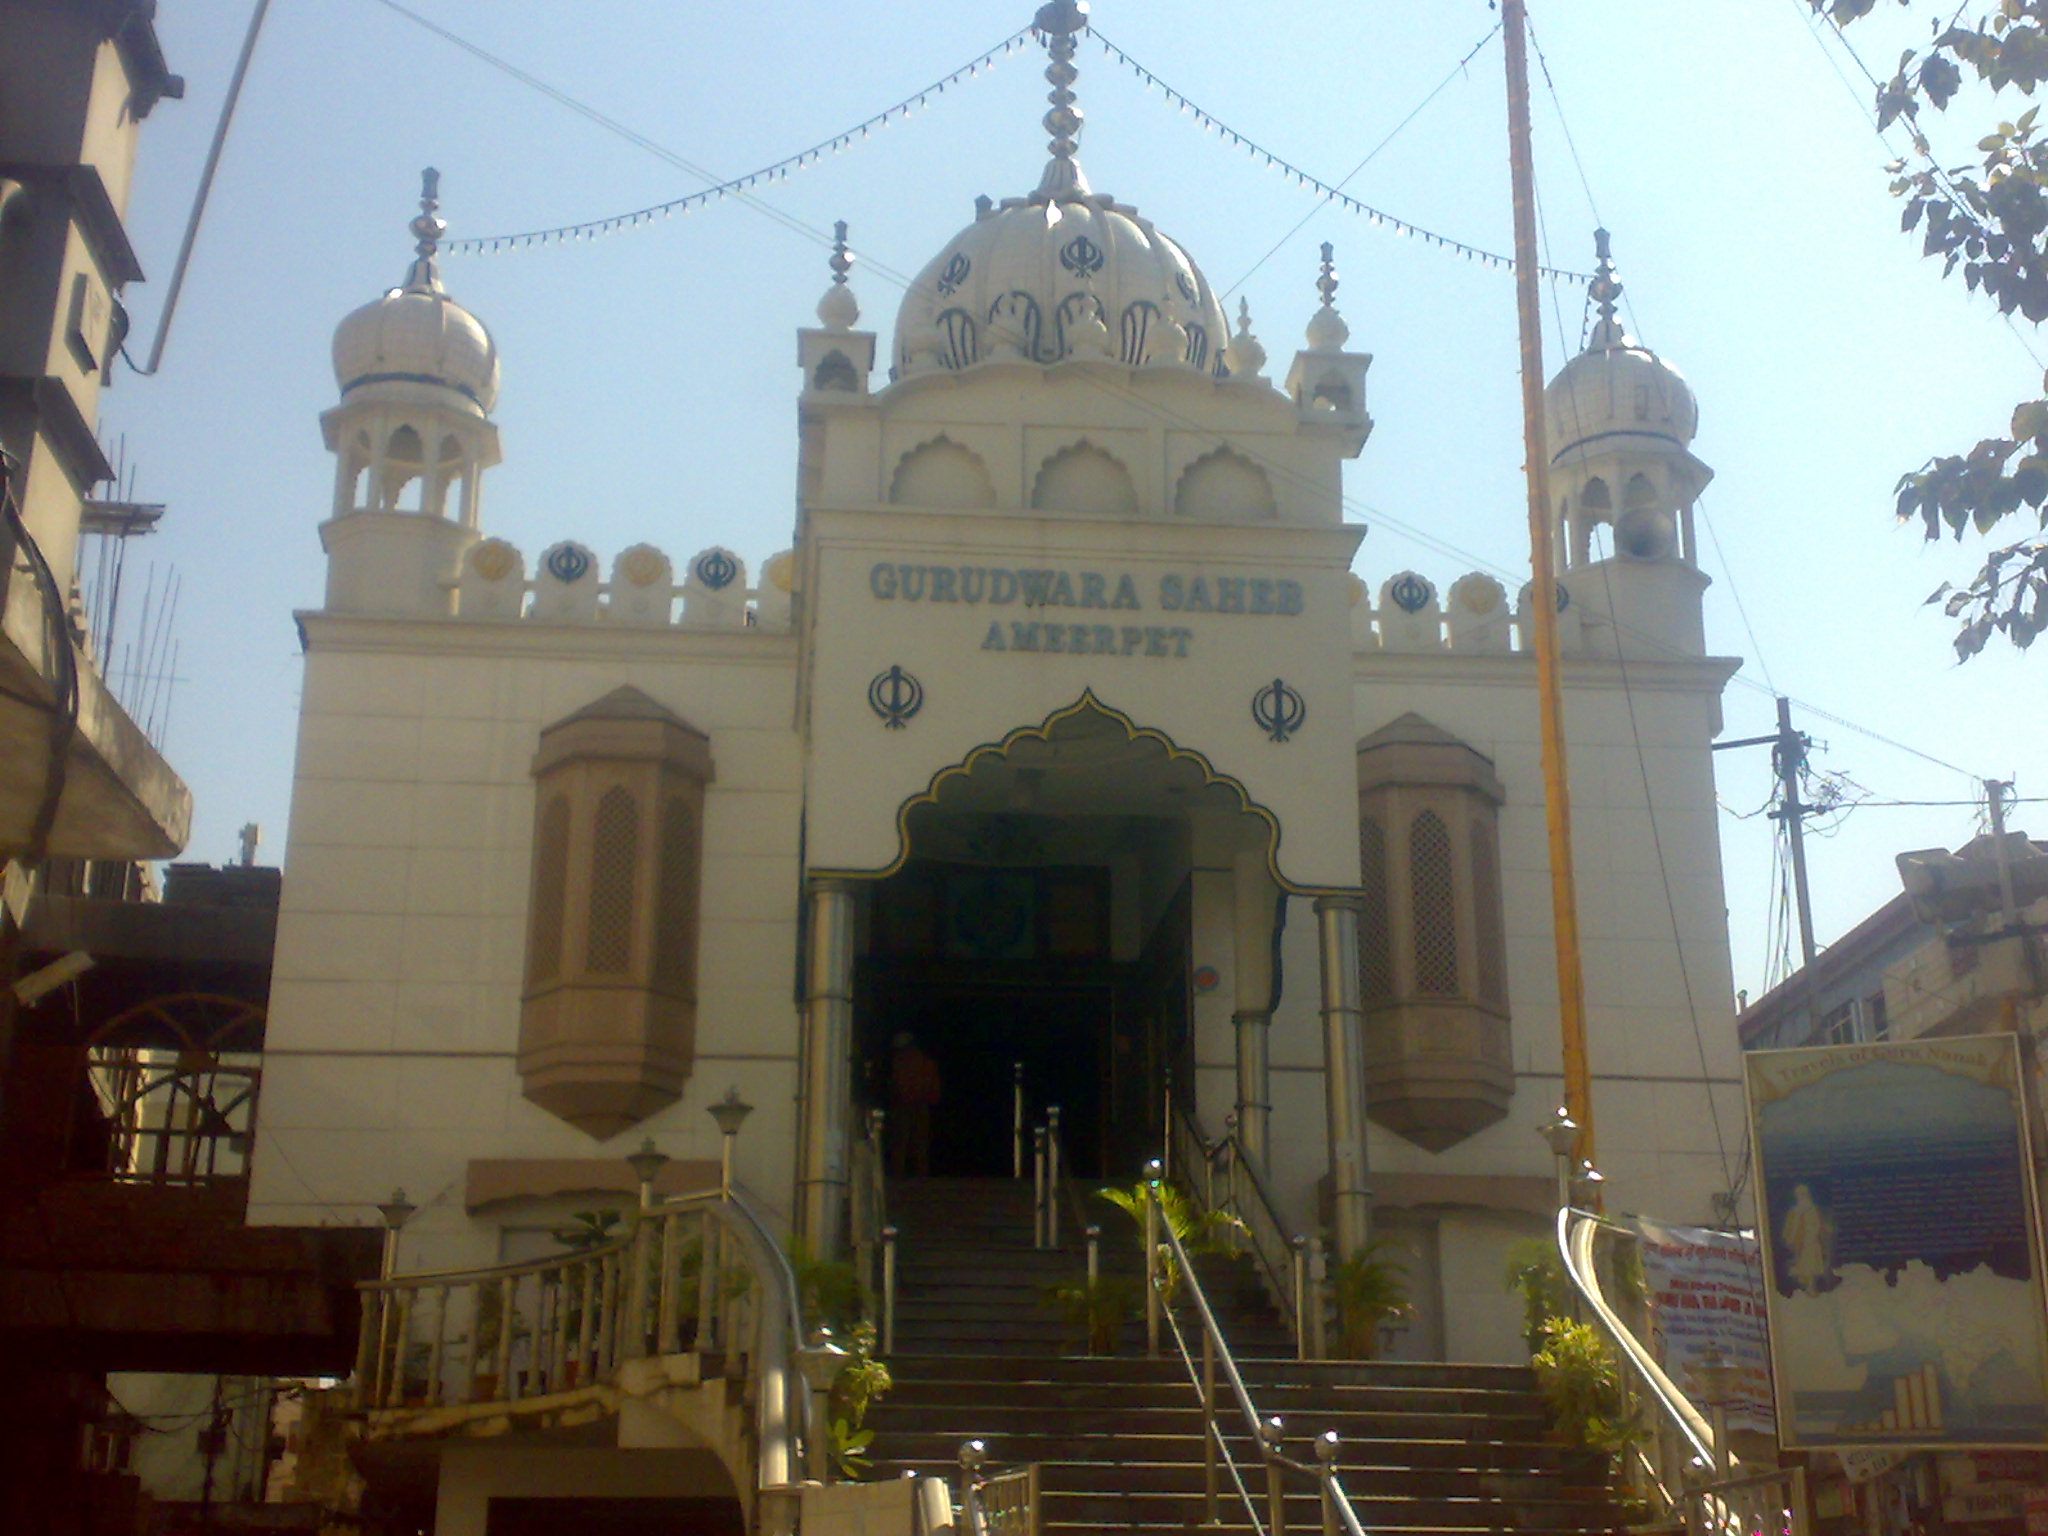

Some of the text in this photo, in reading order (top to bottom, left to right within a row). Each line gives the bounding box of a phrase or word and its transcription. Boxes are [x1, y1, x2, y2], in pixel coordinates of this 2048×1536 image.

[870, 562, 1305, 616] GURUDWARA SAHEB
[980, 620, 1194, 658] AMEERPET
[1778, 1045, 1989, 1081] Travels of Guru Nanak
